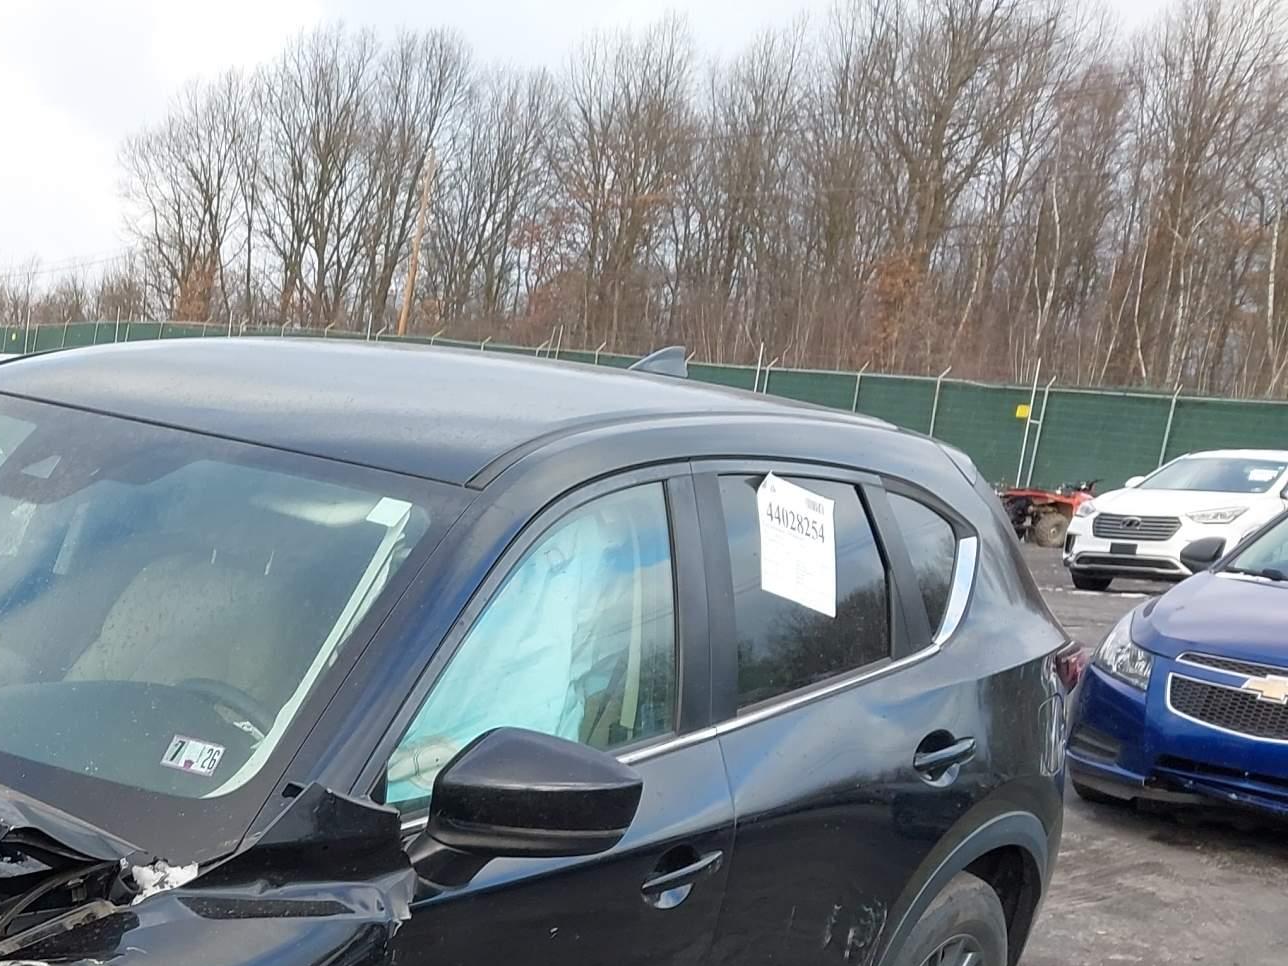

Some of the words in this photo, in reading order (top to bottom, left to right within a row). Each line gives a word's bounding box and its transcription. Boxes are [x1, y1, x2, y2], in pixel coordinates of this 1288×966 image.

[766, 501, 825, 543] 44028254
[169, 740, 186, 761] 7
[200, 748, 221, 770] 26
